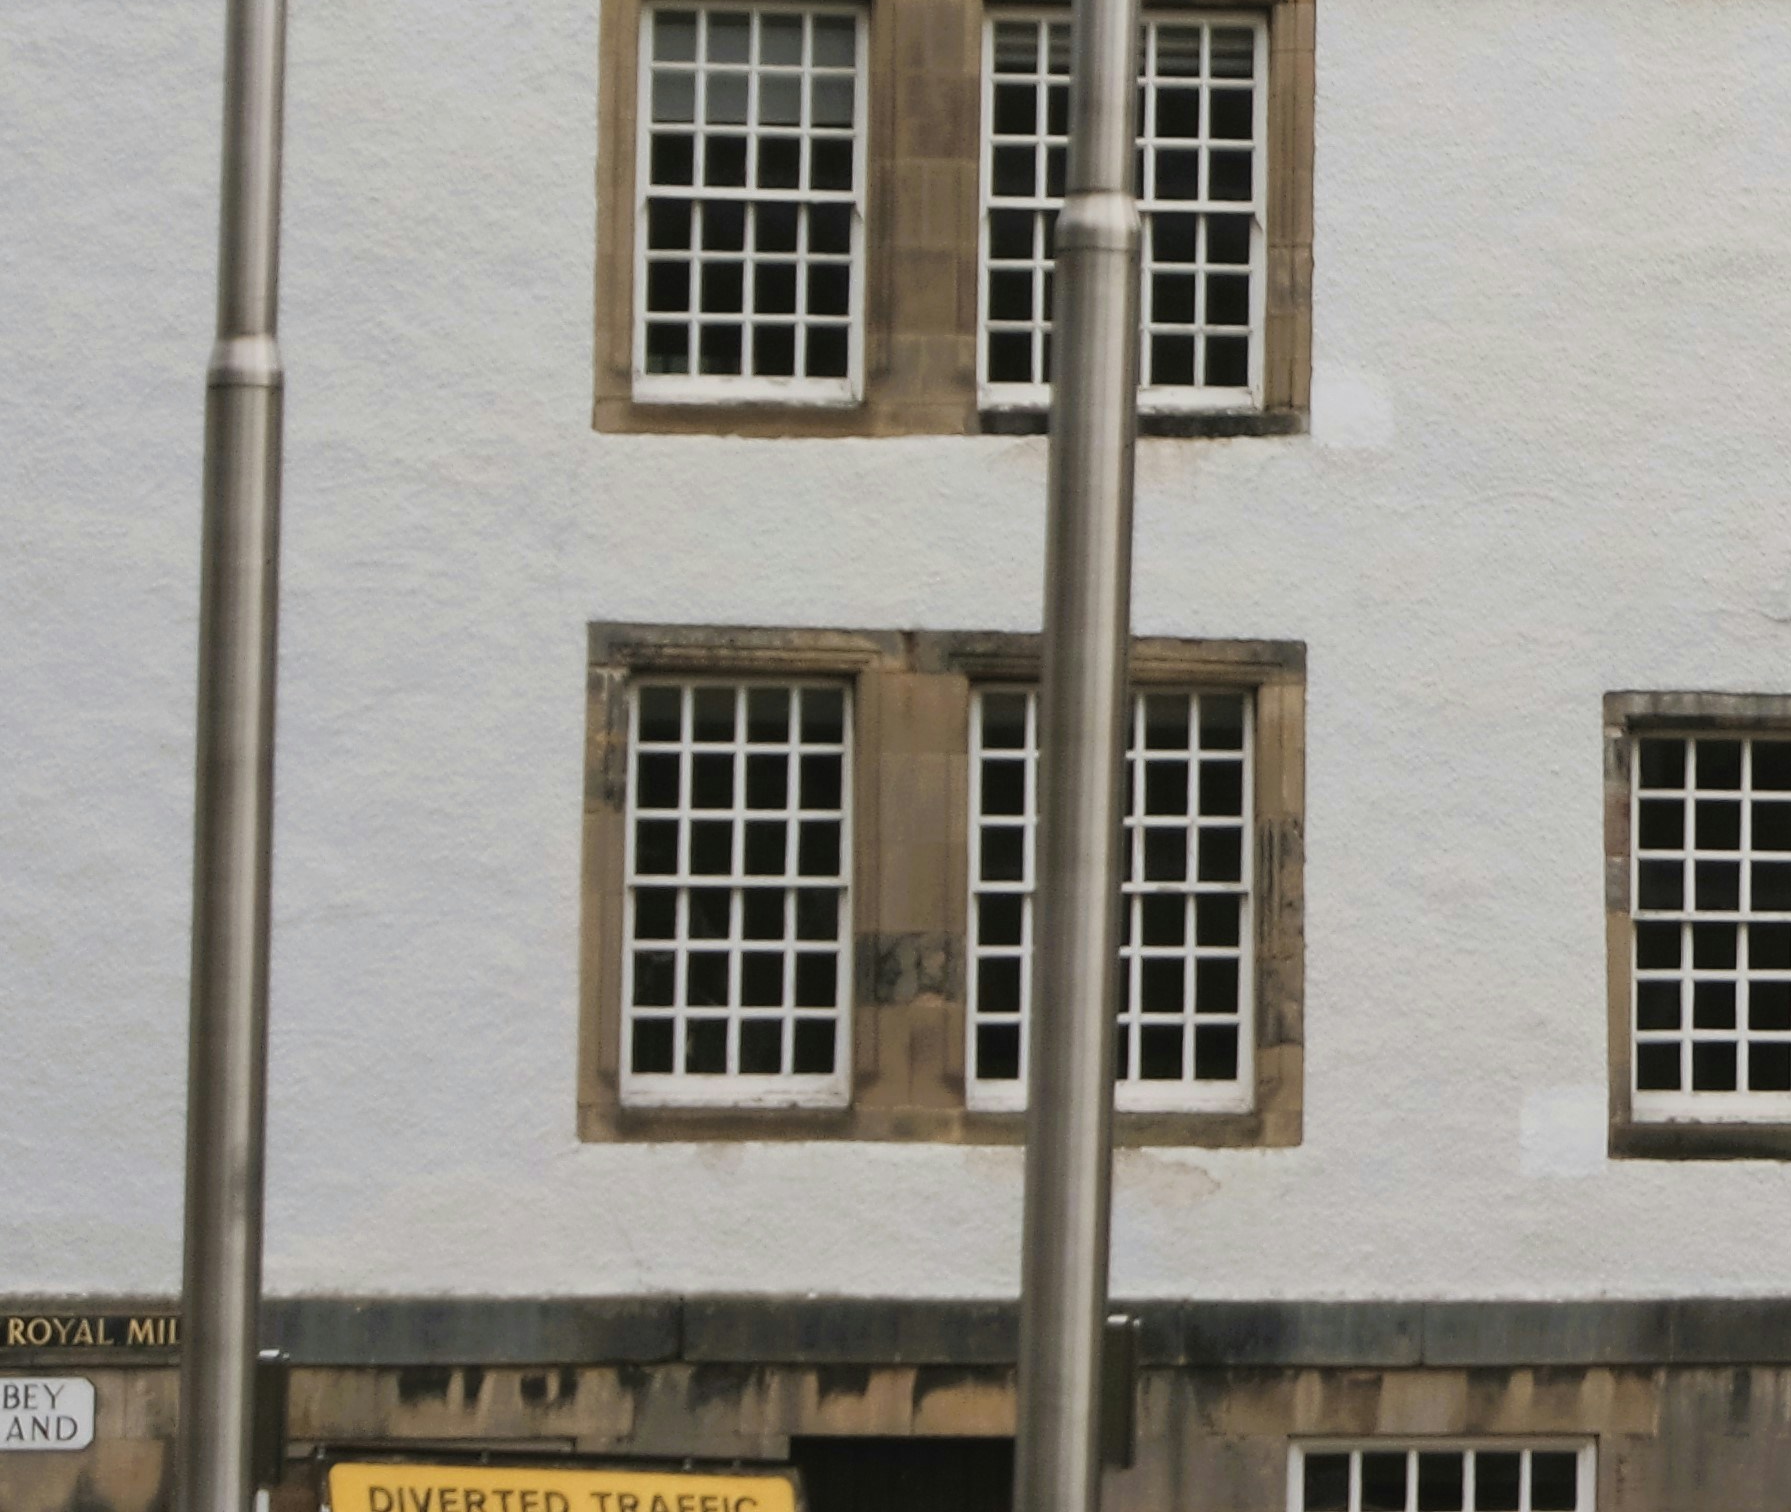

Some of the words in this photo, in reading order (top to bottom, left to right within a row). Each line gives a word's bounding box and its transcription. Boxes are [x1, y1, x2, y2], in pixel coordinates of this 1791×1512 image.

[7, 1316, 114, 1346] ROYAL
[3, 1383, 65, 1410] BEY
[6, 1415, 78, 1442] AND
[368, 1486, 570, 1512] DIVERTED
[589, 1491, 758, 1512] TRAFFIC
